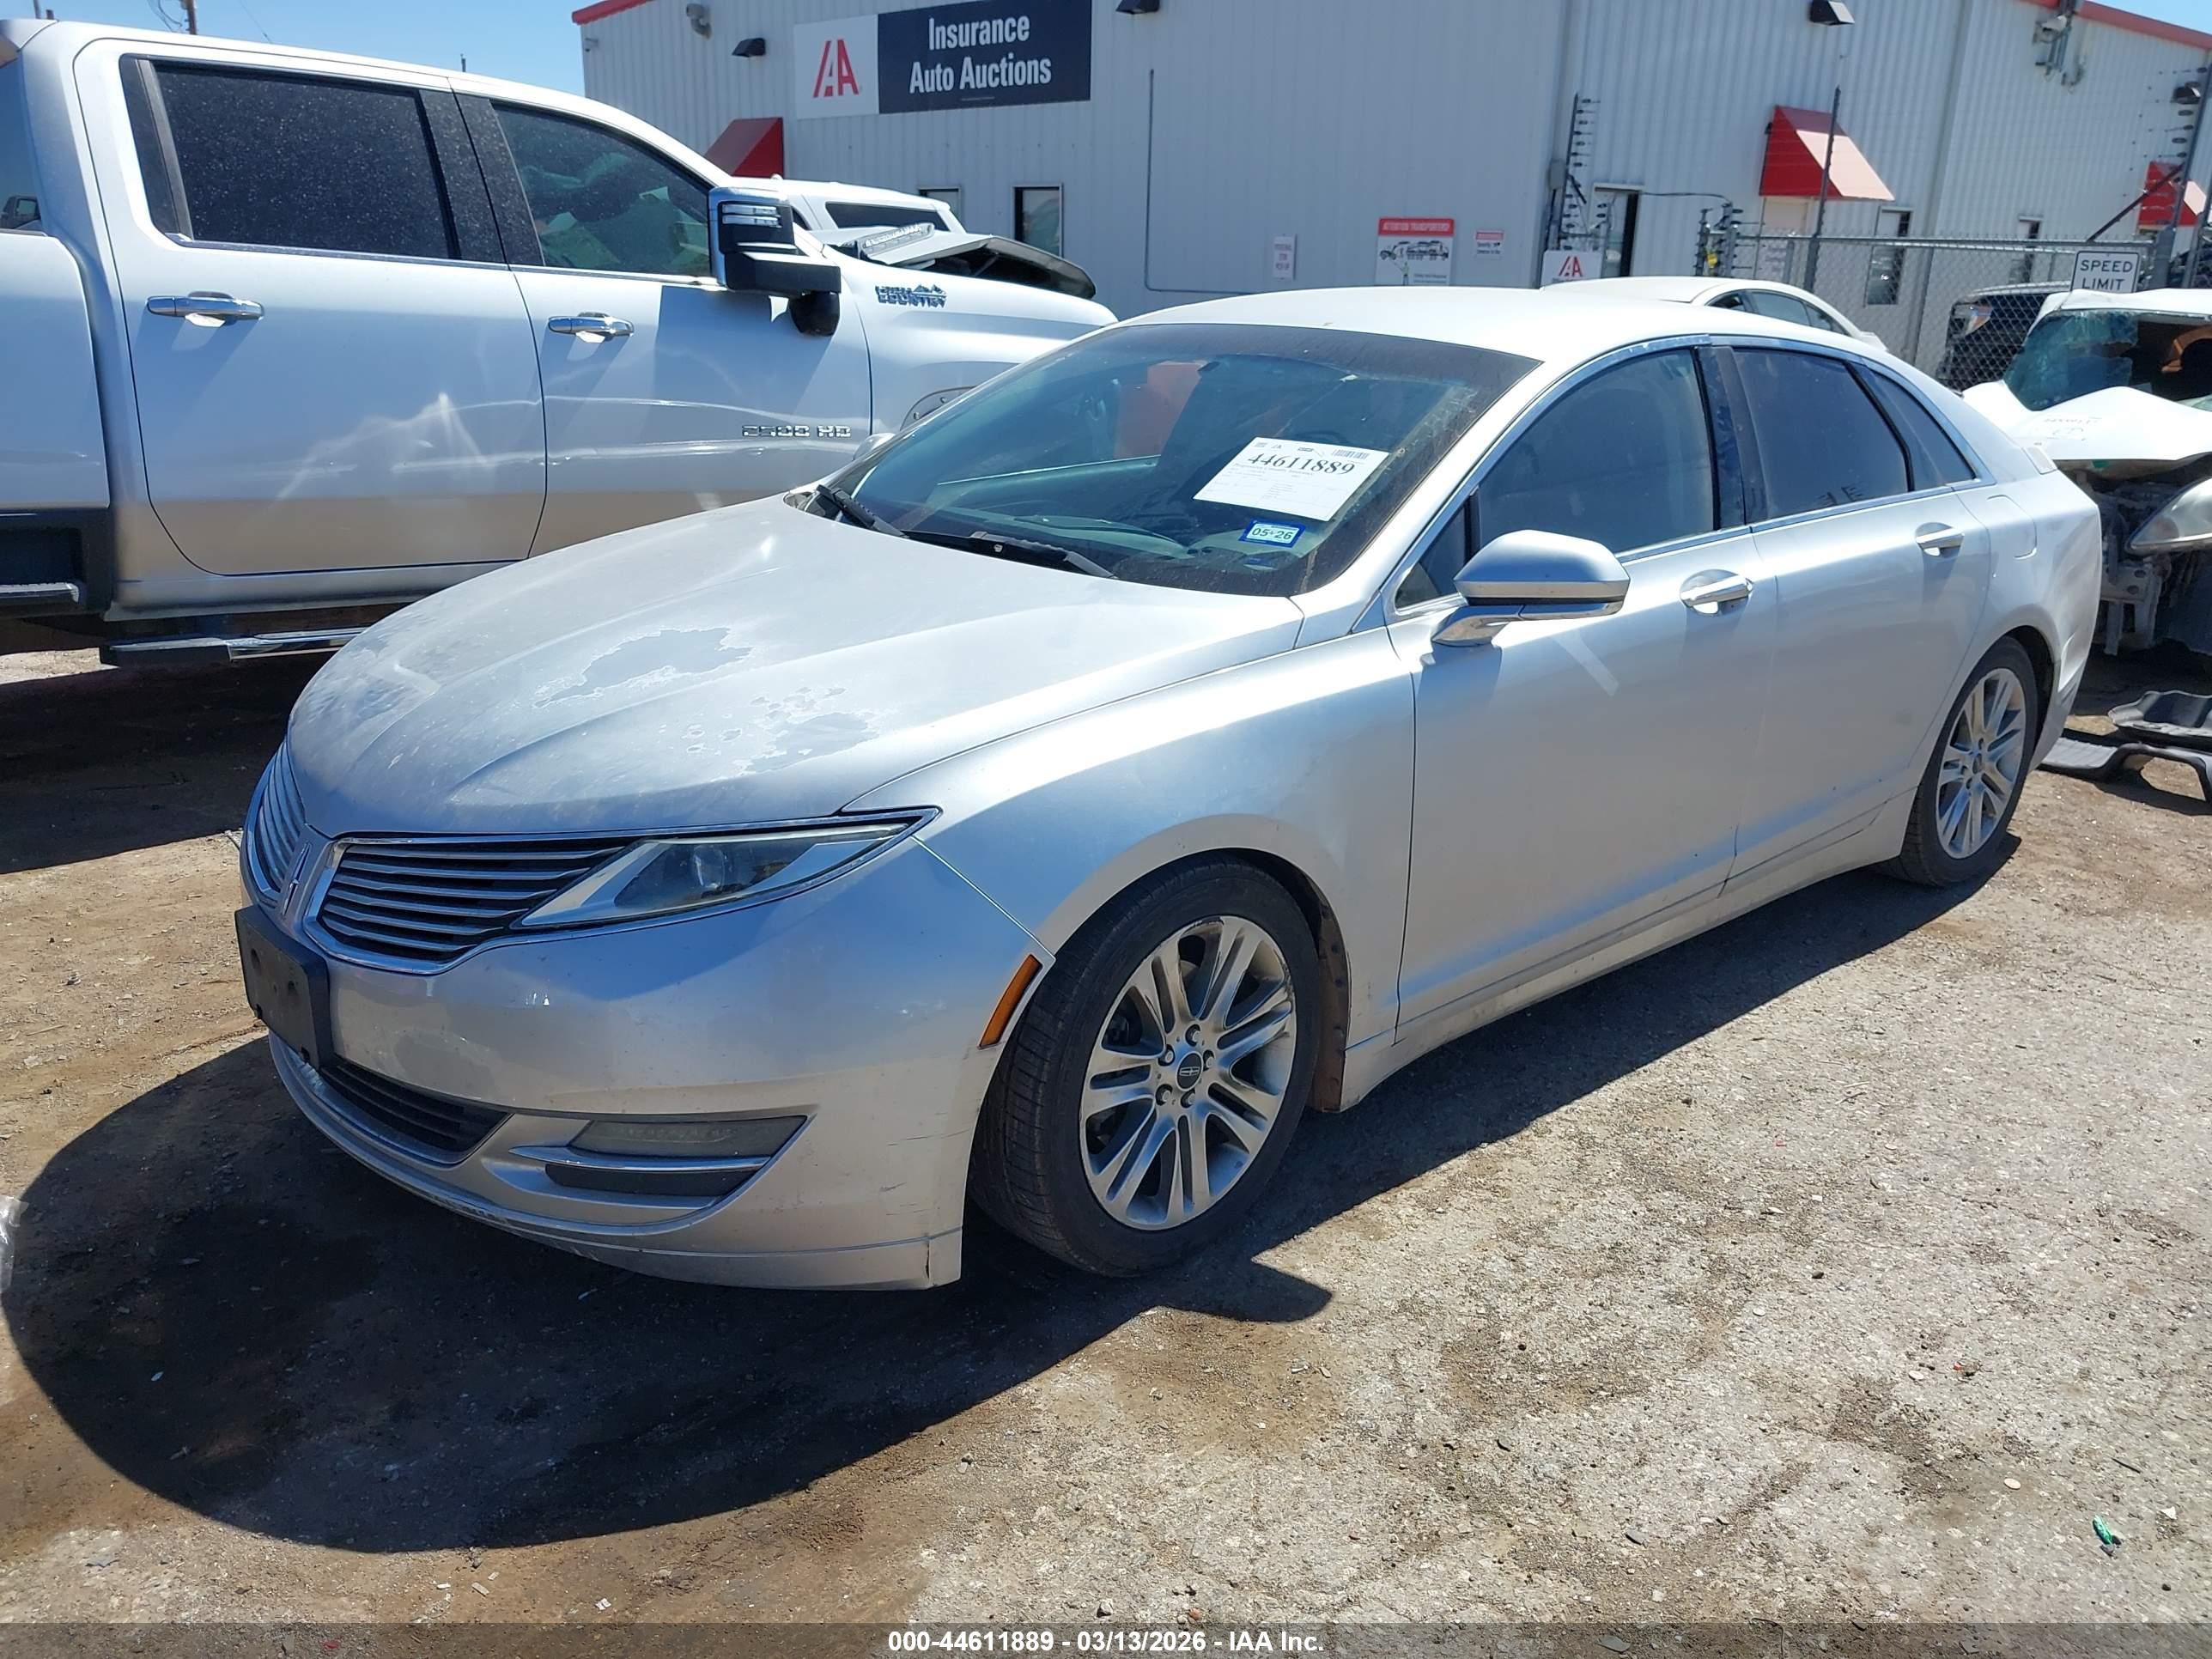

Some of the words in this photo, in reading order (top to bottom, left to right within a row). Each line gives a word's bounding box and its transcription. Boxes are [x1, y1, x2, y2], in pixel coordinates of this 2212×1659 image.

[928, 15, 1030, 51] Insurance
[908, 61, 955, 94] Auto
[958, 52, 1053, 90] Auctions
[2080, 259, 2134, 273] SPEED
[2081, 277, 2125, 290] LIMIT
[817, 425, 852, 438] HD
[1248, 453, 1356, 475] 44611889
[1252, 527, 1271, 538] 05
[1274, 530, 1294, 541] 26
